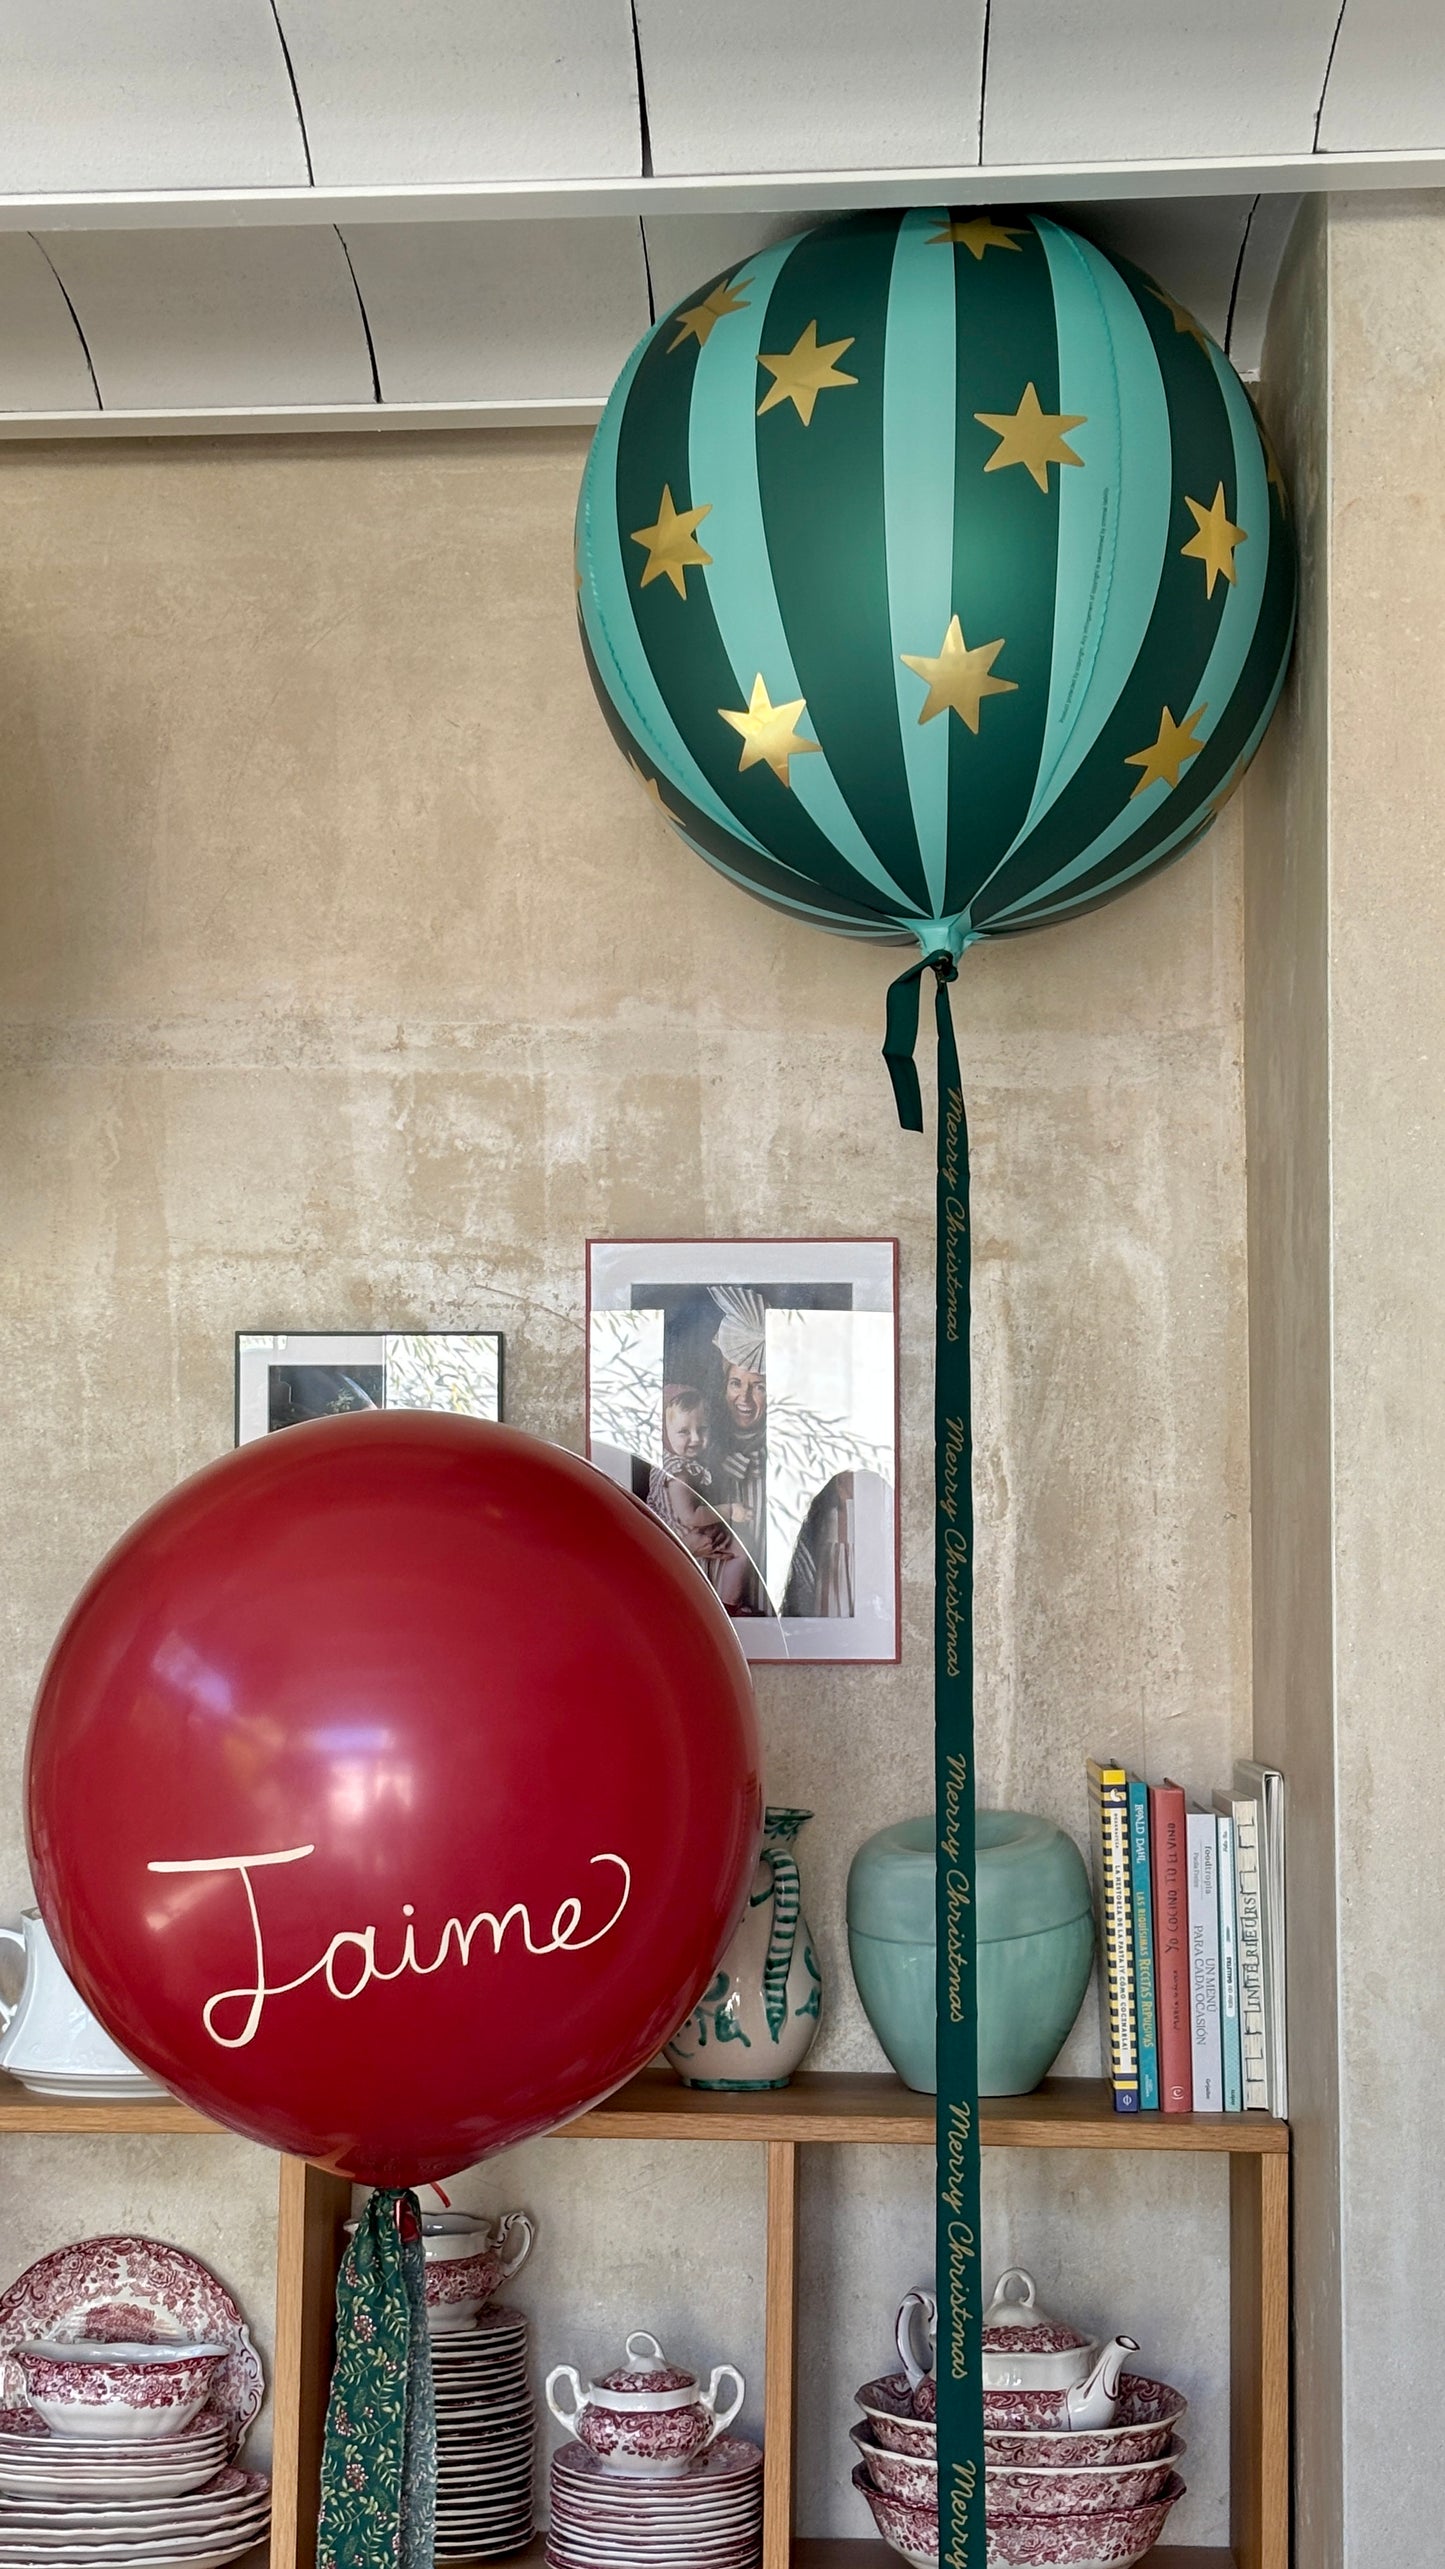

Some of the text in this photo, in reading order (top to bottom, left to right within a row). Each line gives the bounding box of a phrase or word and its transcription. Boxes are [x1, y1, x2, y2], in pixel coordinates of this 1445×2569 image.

[942, 1087, 965, 1342] Merry Christmas
[941, 1416, 967, 1677] Merry Christmas
[1135, 1804, 1147, 1864] ROALD DAHL
[1167, 1822, 1178, 1849] VINO
[1167, 1852, 1178, 1864] EL
[941, 1753, 971, 2023] Merry Christmas
[1115, 1864, 1121, 1875] LA
[1115, 1876, 1123, 1915] HISTORIA
[1204, 1845, 1213, 1895] foodtropia
[147, 1843, 631, 2048] Jaime
[1116, 1917, 1123, 1928] DE
[1117, 1929, 1123, 1939] LA
[1165, 1938, 1180, 1954] YO
[1136, 1892, 1154, 2048] LAS RIQUÍSIMAS RECETAS REPULSIVAS
[1194, 1925, 1208, 2046] PARA CADA OCASIÓN
[1205, 1957, 1218, 2013] UN MENÚ
[942, 2100, 976, 2380] Merry Christmas
[944, 2459, 977, 2569] Merry
